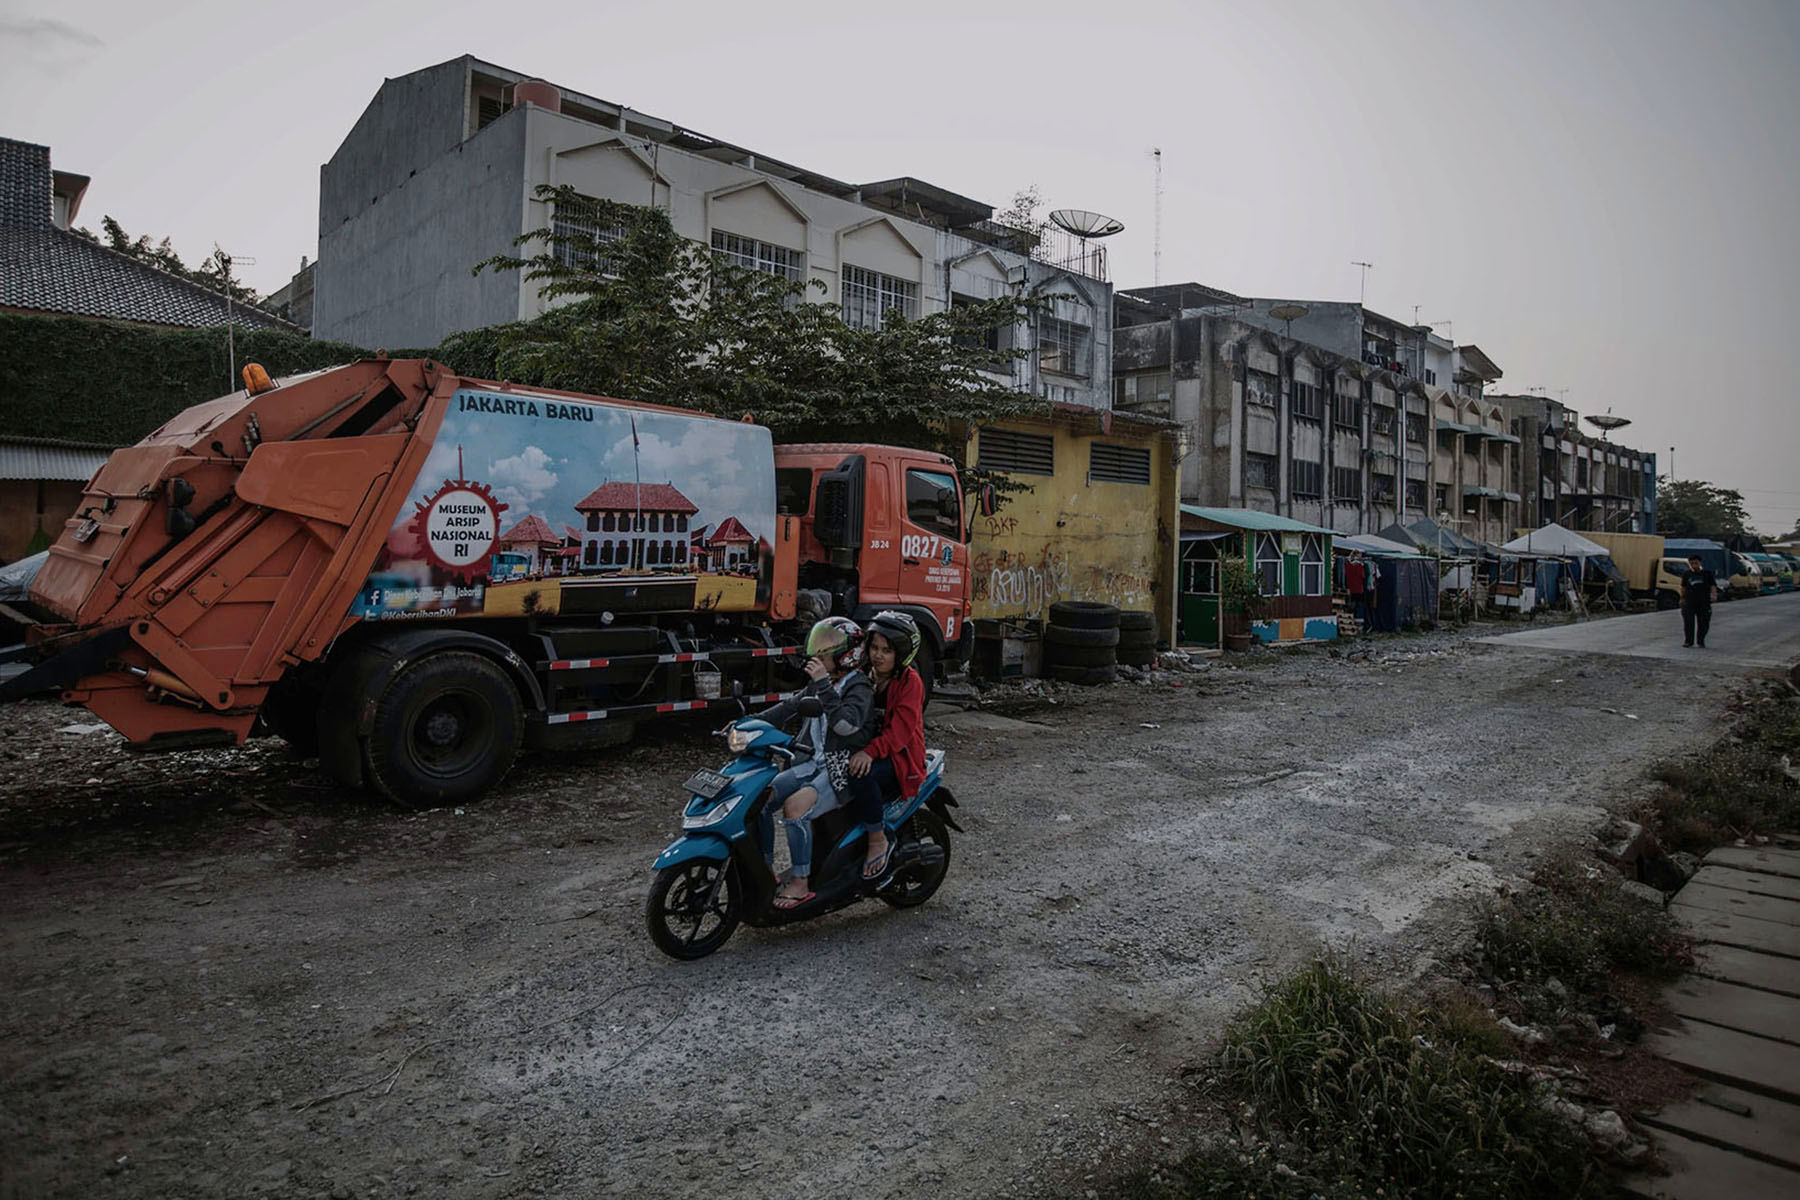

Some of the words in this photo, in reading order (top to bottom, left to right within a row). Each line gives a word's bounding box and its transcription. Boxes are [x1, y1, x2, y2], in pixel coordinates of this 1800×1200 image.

[459, 395, 539, 417] JAKARTA
[545, 403, 594, 422] BARU
[439, 504, 486, 514] MUSEUM
[446, 517, 480, 527] ARSIP
[431, 530, 492, 541] NASIONAL
[454, 543, 469, 557] RI
[901, 535, 940, 559] 0827
[946, 616, 955, 638] B
